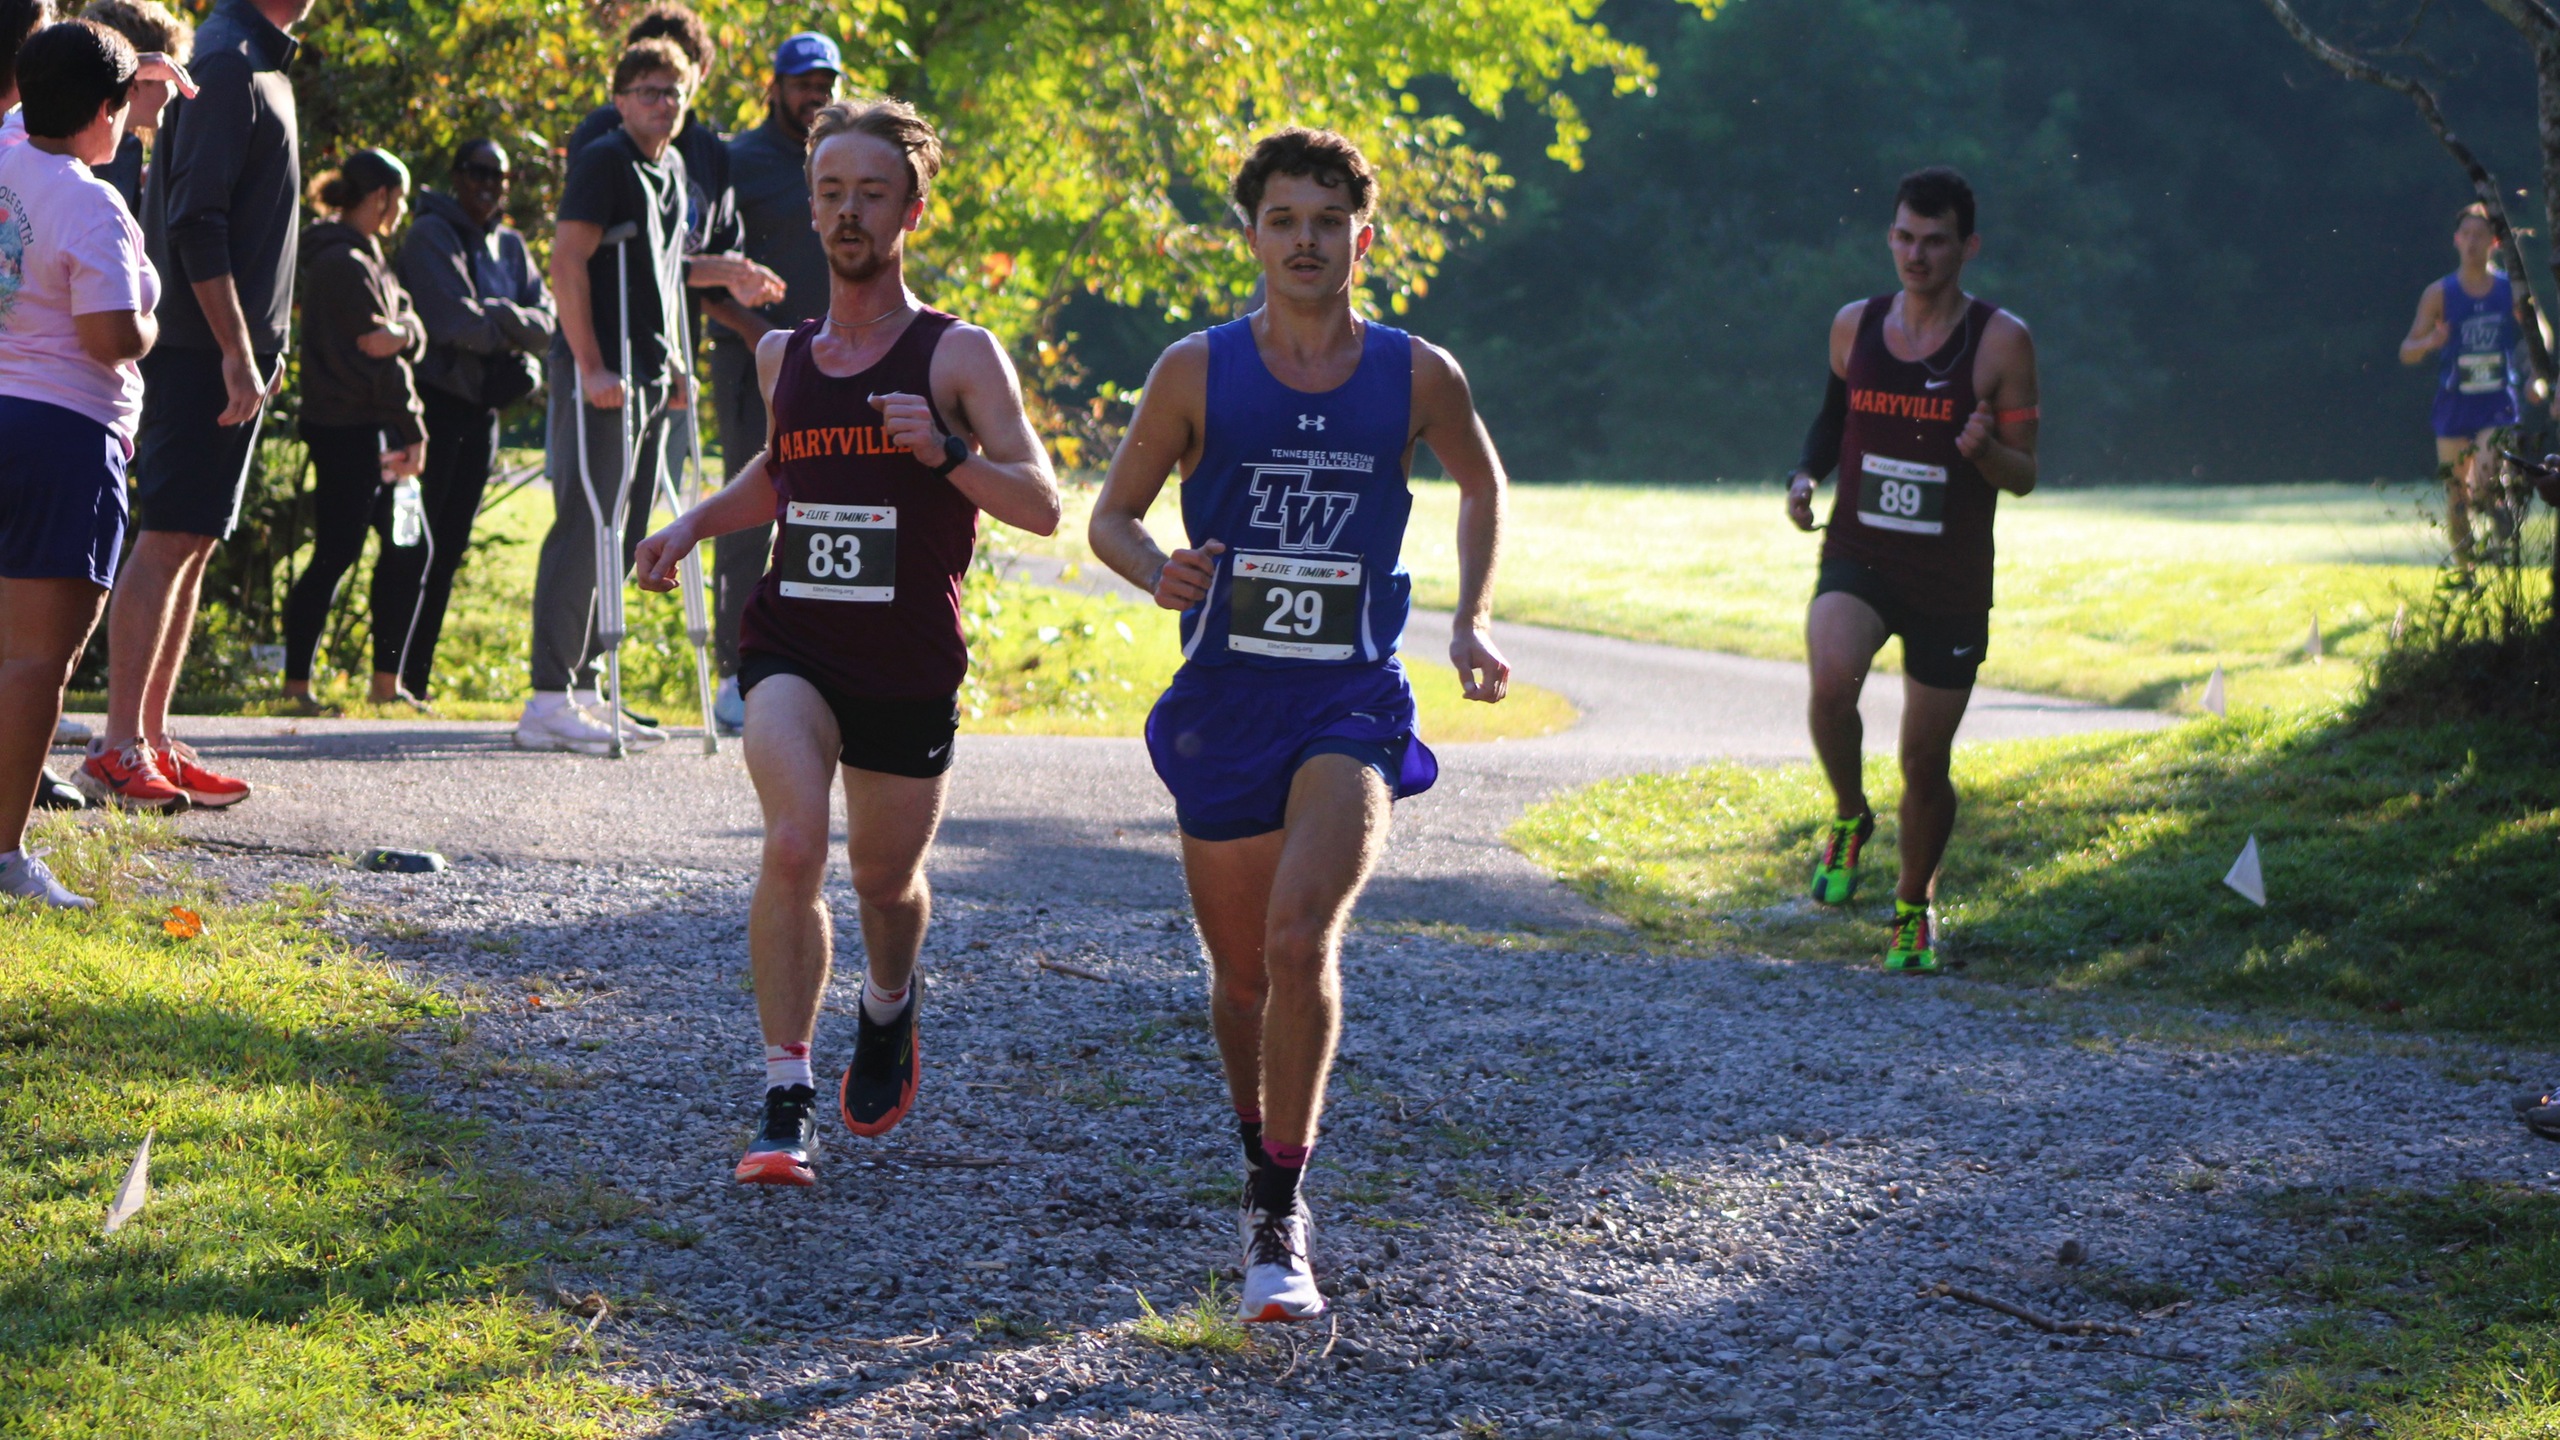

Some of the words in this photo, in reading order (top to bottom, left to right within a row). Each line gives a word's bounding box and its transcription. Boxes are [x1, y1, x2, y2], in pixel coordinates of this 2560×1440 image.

[14, 199, 35, 246] EARTH
[1850, 389, 1953, 422] MARYVILLE
[1271, 449, 1327, 460] TENNESSEE
[1329, 451, 1375, 463] WESLEYAN
[1308, 459, 1373, 470] BULLDOGS
[1249, 467, 1359, 550] TW
[1879, 480, 1921, 516] 89
[806, 509, 831, 521] ELITE
[834, 511, 870, 523] TIMING
[807, 532, 861, 579] 83
[1261, 562, 1293, 575] ELITE
[1296, 566, 1334, 578] TIMING
[1263, 587, 1323, 636] 29
